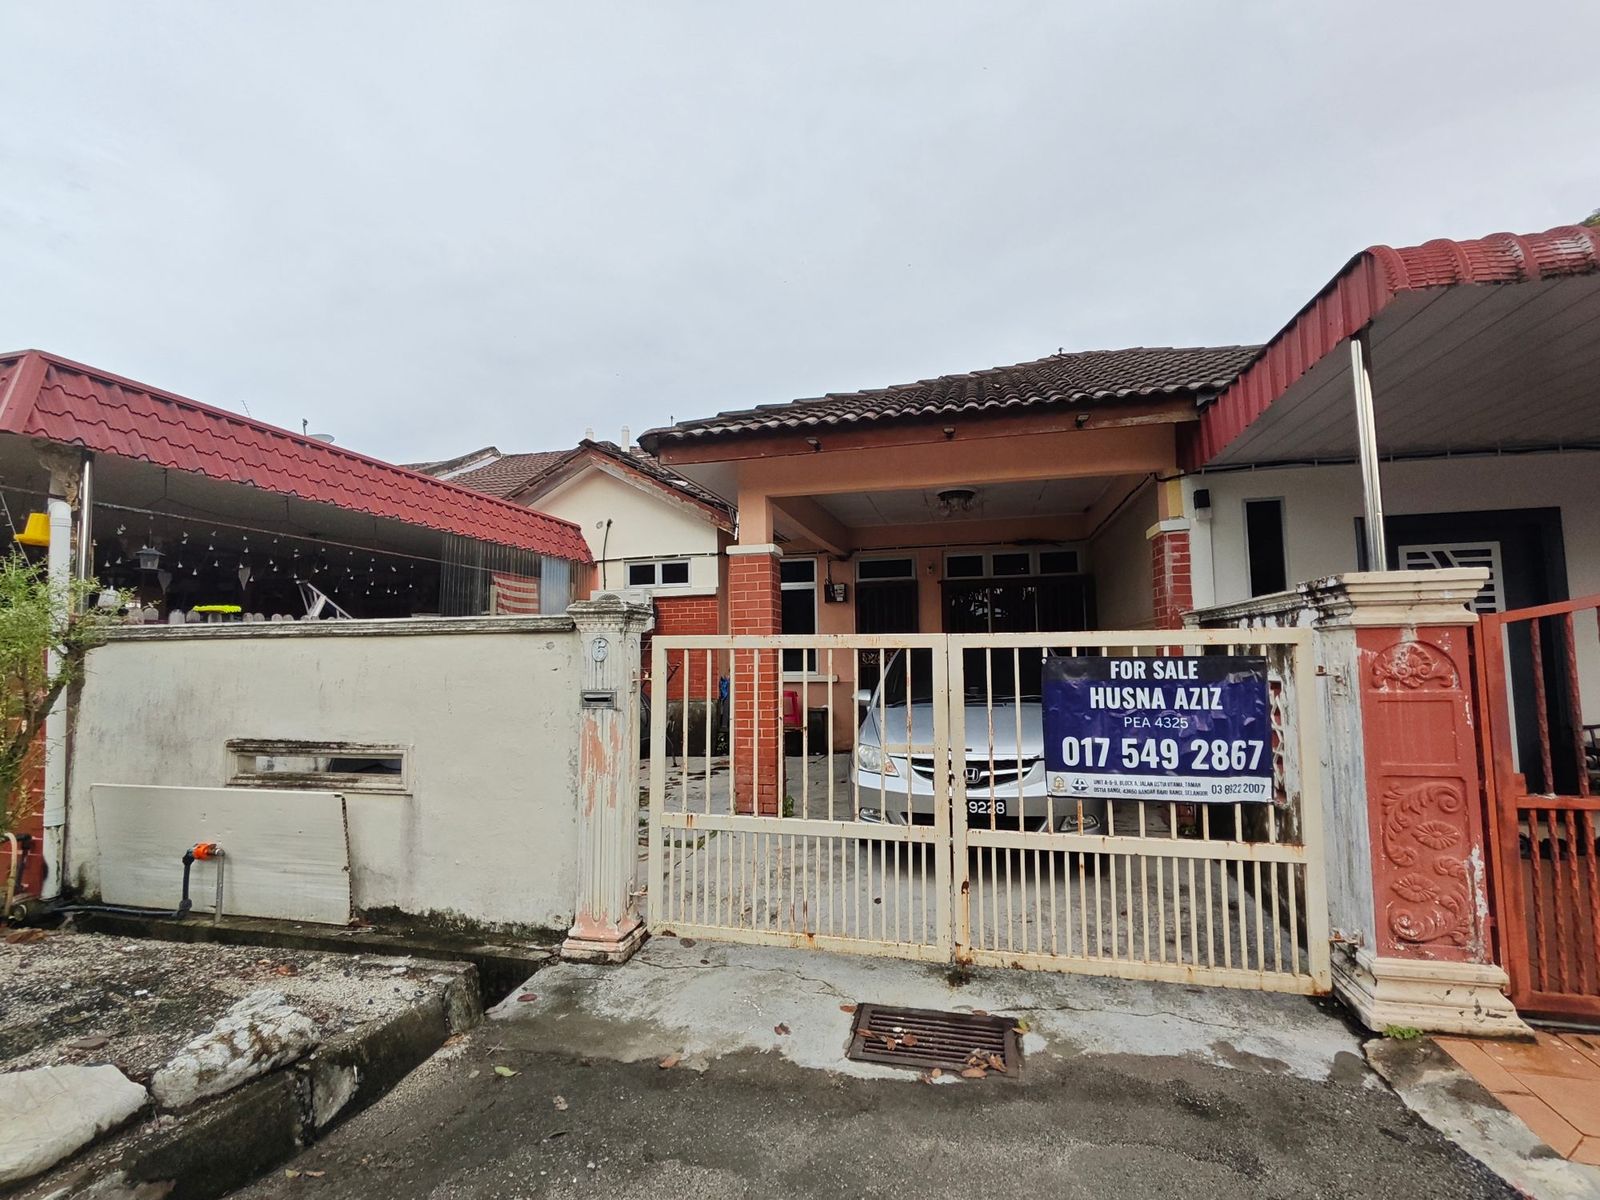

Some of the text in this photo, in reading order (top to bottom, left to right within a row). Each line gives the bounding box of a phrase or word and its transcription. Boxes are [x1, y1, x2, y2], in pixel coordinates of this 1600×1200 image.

[1110, 660, 1199, 680] FOR SALE
[1090, 687, 1223, 710] HUSNA AZIZ
[1124, 717, 1189, 729] PEA 4325
[1062, 736, 1264, 771] 017 549 2867
[1211, 784, 1223, 795] 03
[1243, 783, 1266, 795] 2007
